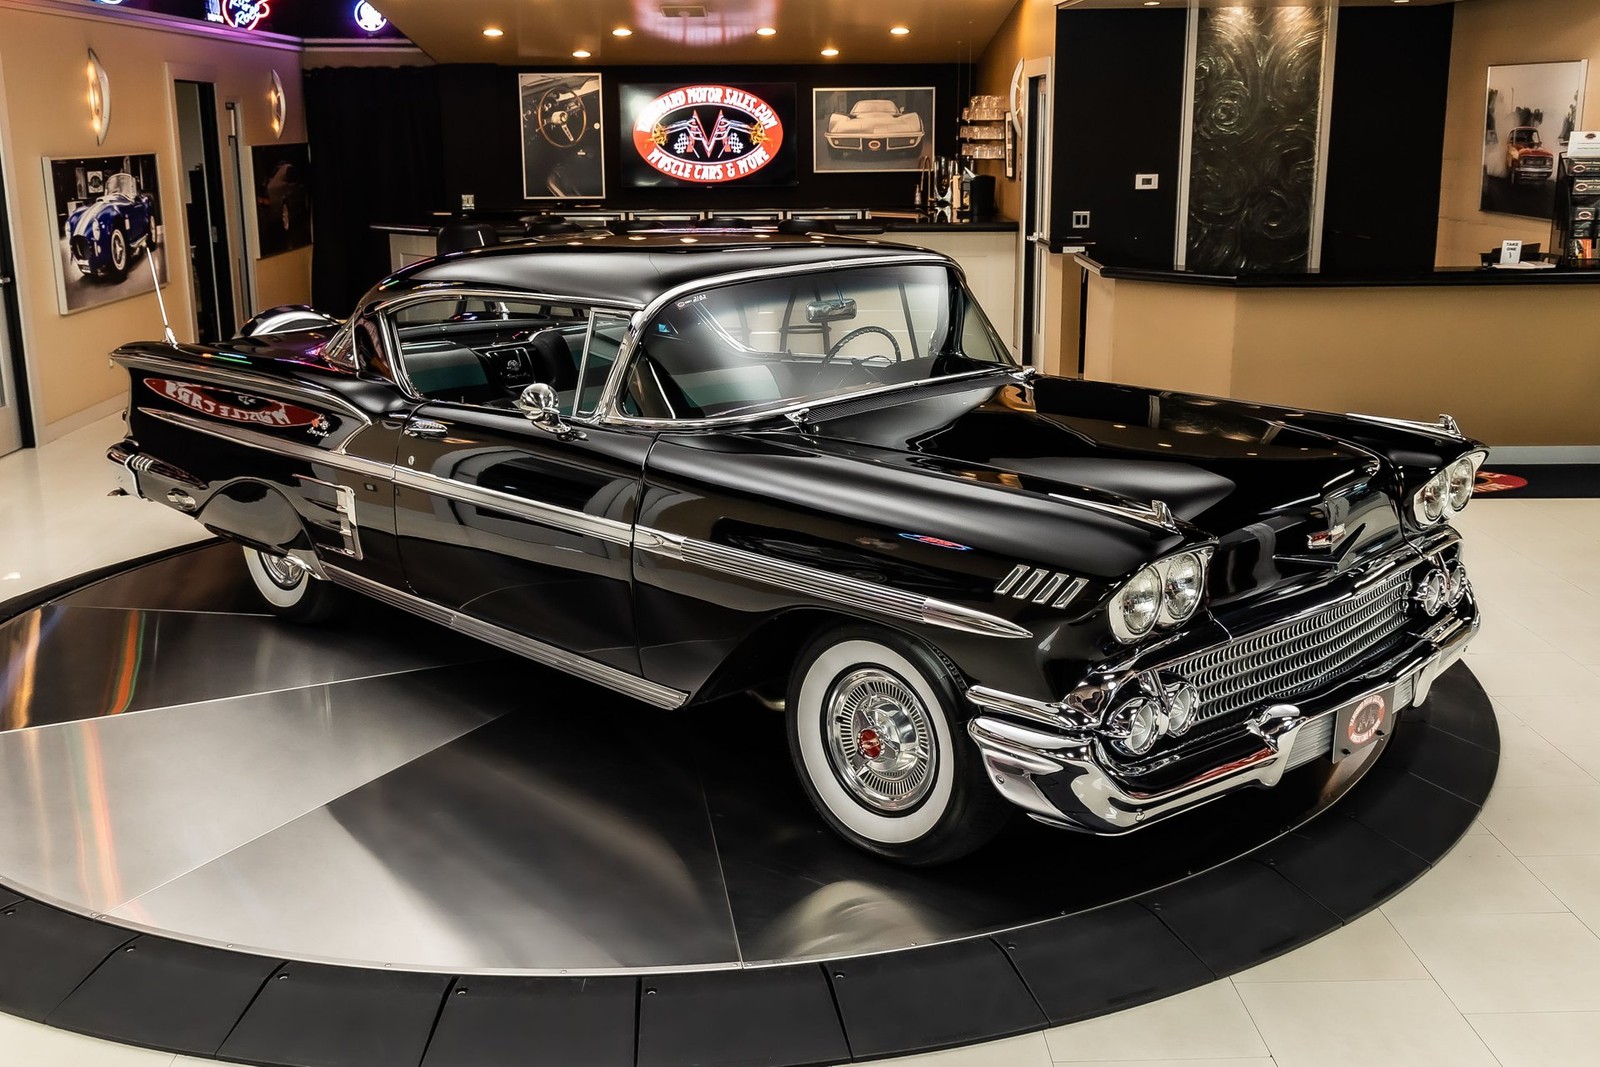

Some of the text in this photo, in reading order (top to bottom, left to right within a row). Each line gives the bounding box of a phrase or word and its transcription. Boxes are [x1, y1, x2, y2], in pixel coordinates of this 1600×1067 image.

[685, 87, 723, 104] MOTOR
[723, 88, 778, 130] SALES.COM
[646, 146, 770, 180] MUSCLE CARS & MORE
